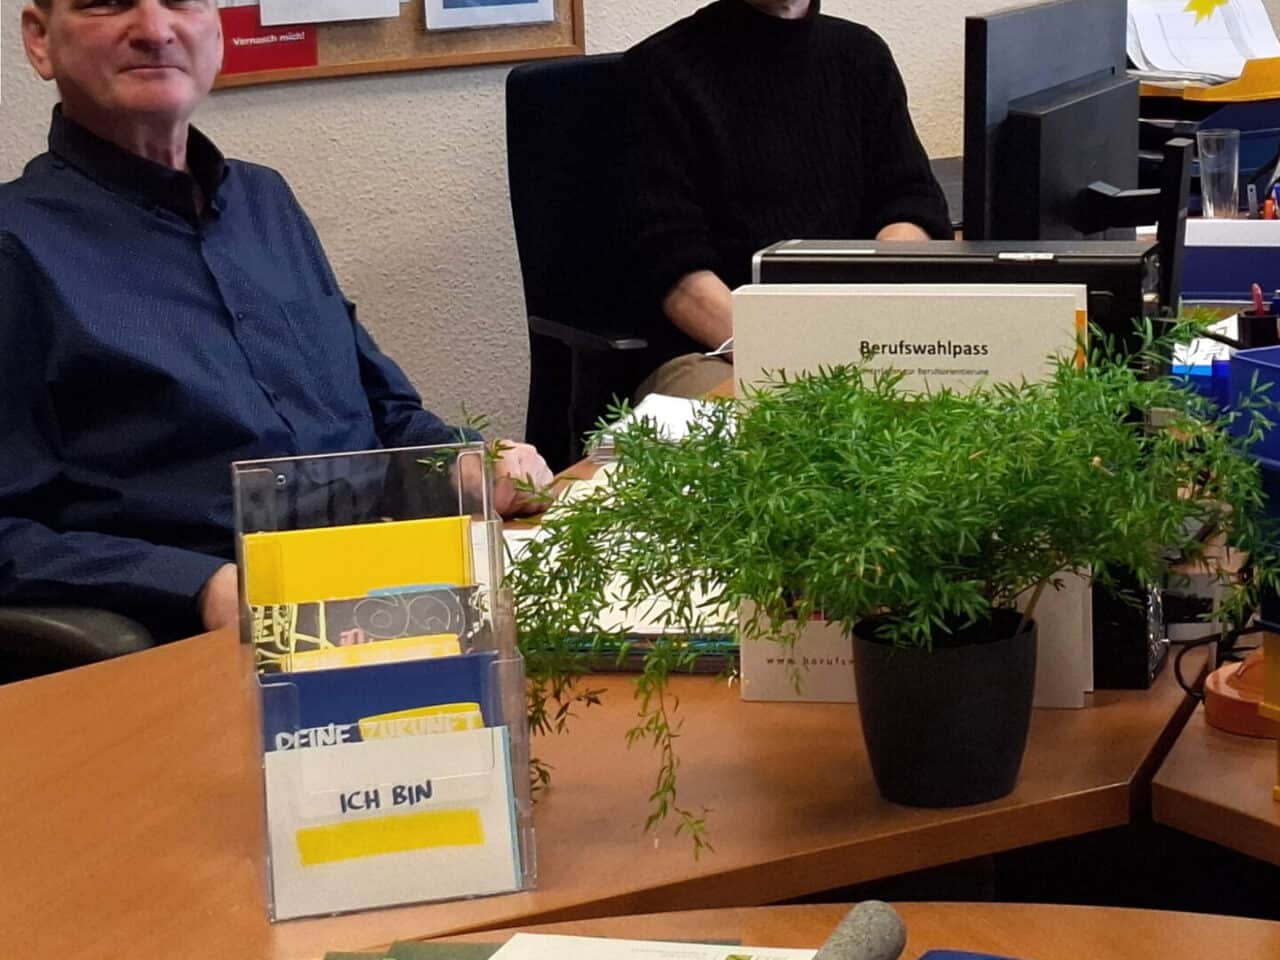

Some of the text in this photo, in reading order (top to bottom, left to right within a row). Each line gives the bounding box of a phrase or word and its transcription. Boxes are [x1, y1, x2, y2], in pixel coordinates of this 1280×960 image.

[860, 340, 989, 359] Berufswahlpass
[275, 723, 351, 751] DEINE
[339, 780, 434, 814] ICH BIN
